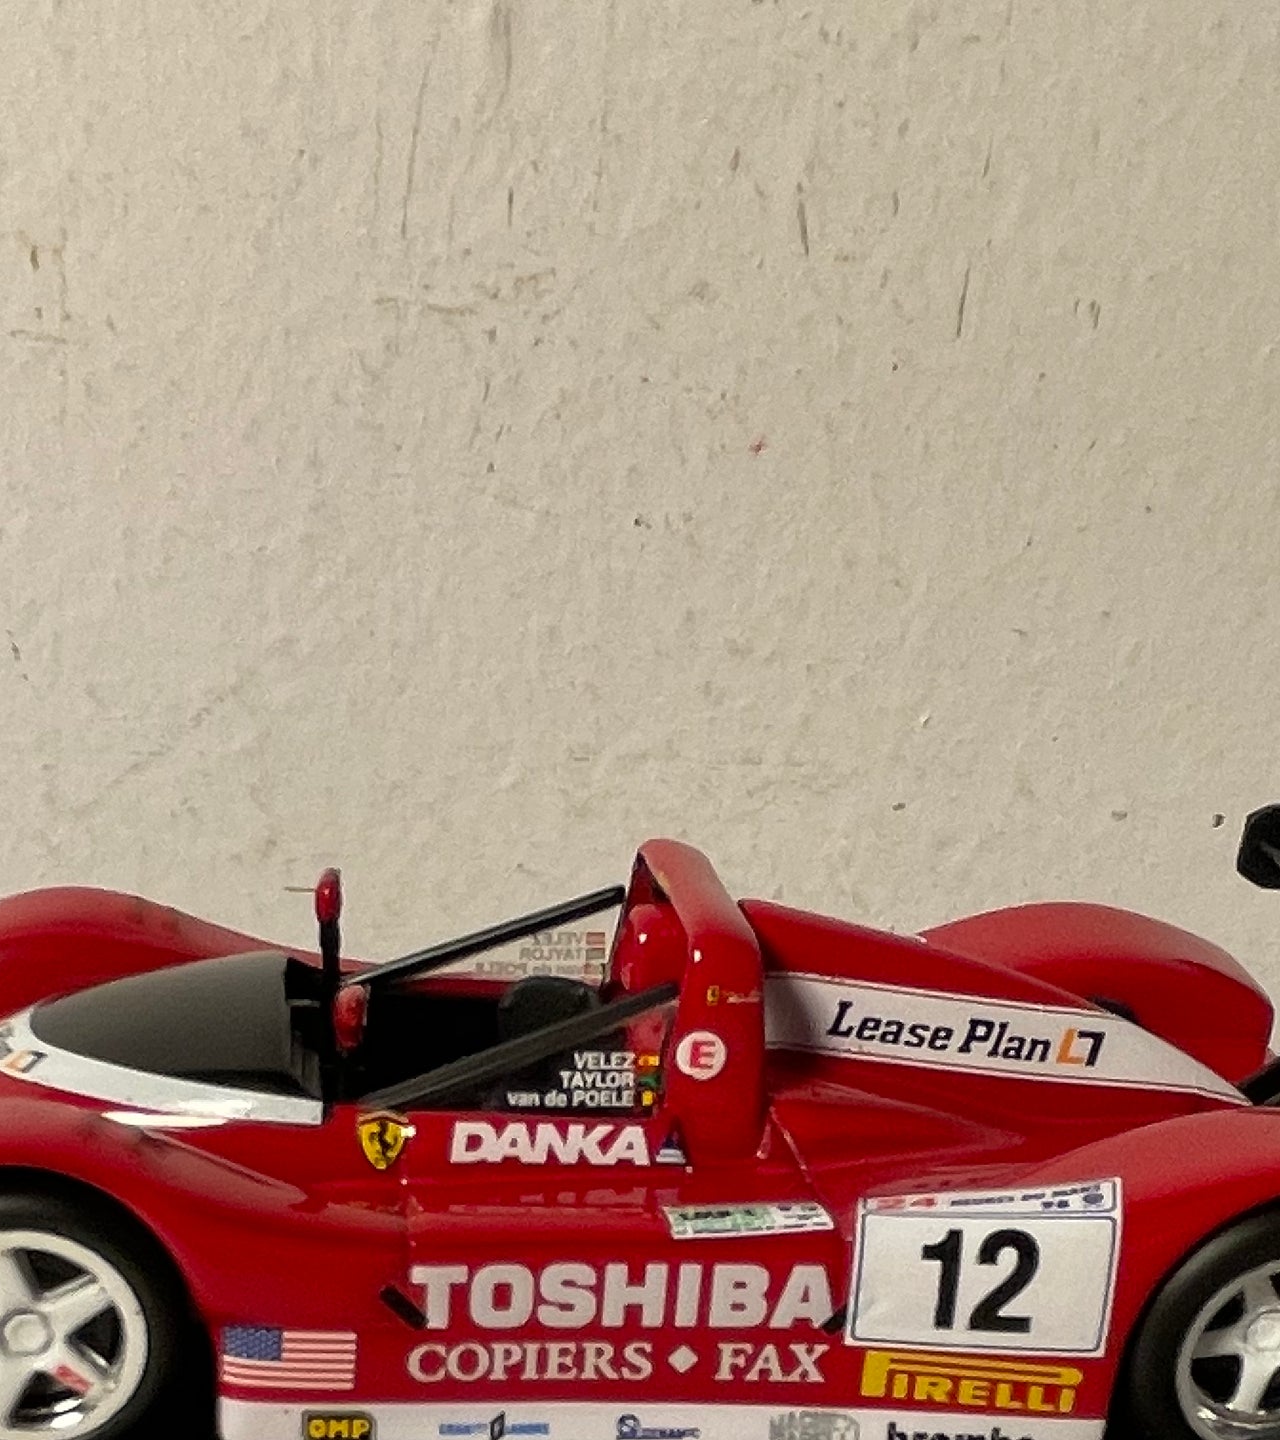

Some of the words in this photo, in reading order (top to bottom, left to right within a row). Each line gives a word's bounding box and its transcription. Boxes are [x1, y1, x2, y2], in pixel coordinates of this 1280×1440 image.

[826, 1000, 953, 1051] Lease
[957, 1018, 1051, 1062] Plan
[574, 1052, 636, 1070] VELEZ
[689, 1040, 717, 1069] E
[507, 1091, 540, 1107] van
[544, 1089, 568, 1107] de
[571, 1090, 635, 1107] POELE
[560, 1070, 636, 1088] TAYLOR
[450, 1121, 651, 1166] DANKA
[409, 1262, 834, 1330] TOSHIBA
[921, 1229, 1040, 1333] 12
[407, 1342, 654, 1383] COPIERS
[714, 1342, 832, 1383] FAX
[861, 1350, 1083, 1413] PIRELLI
[308, 1418, 370, 1440] OMP
